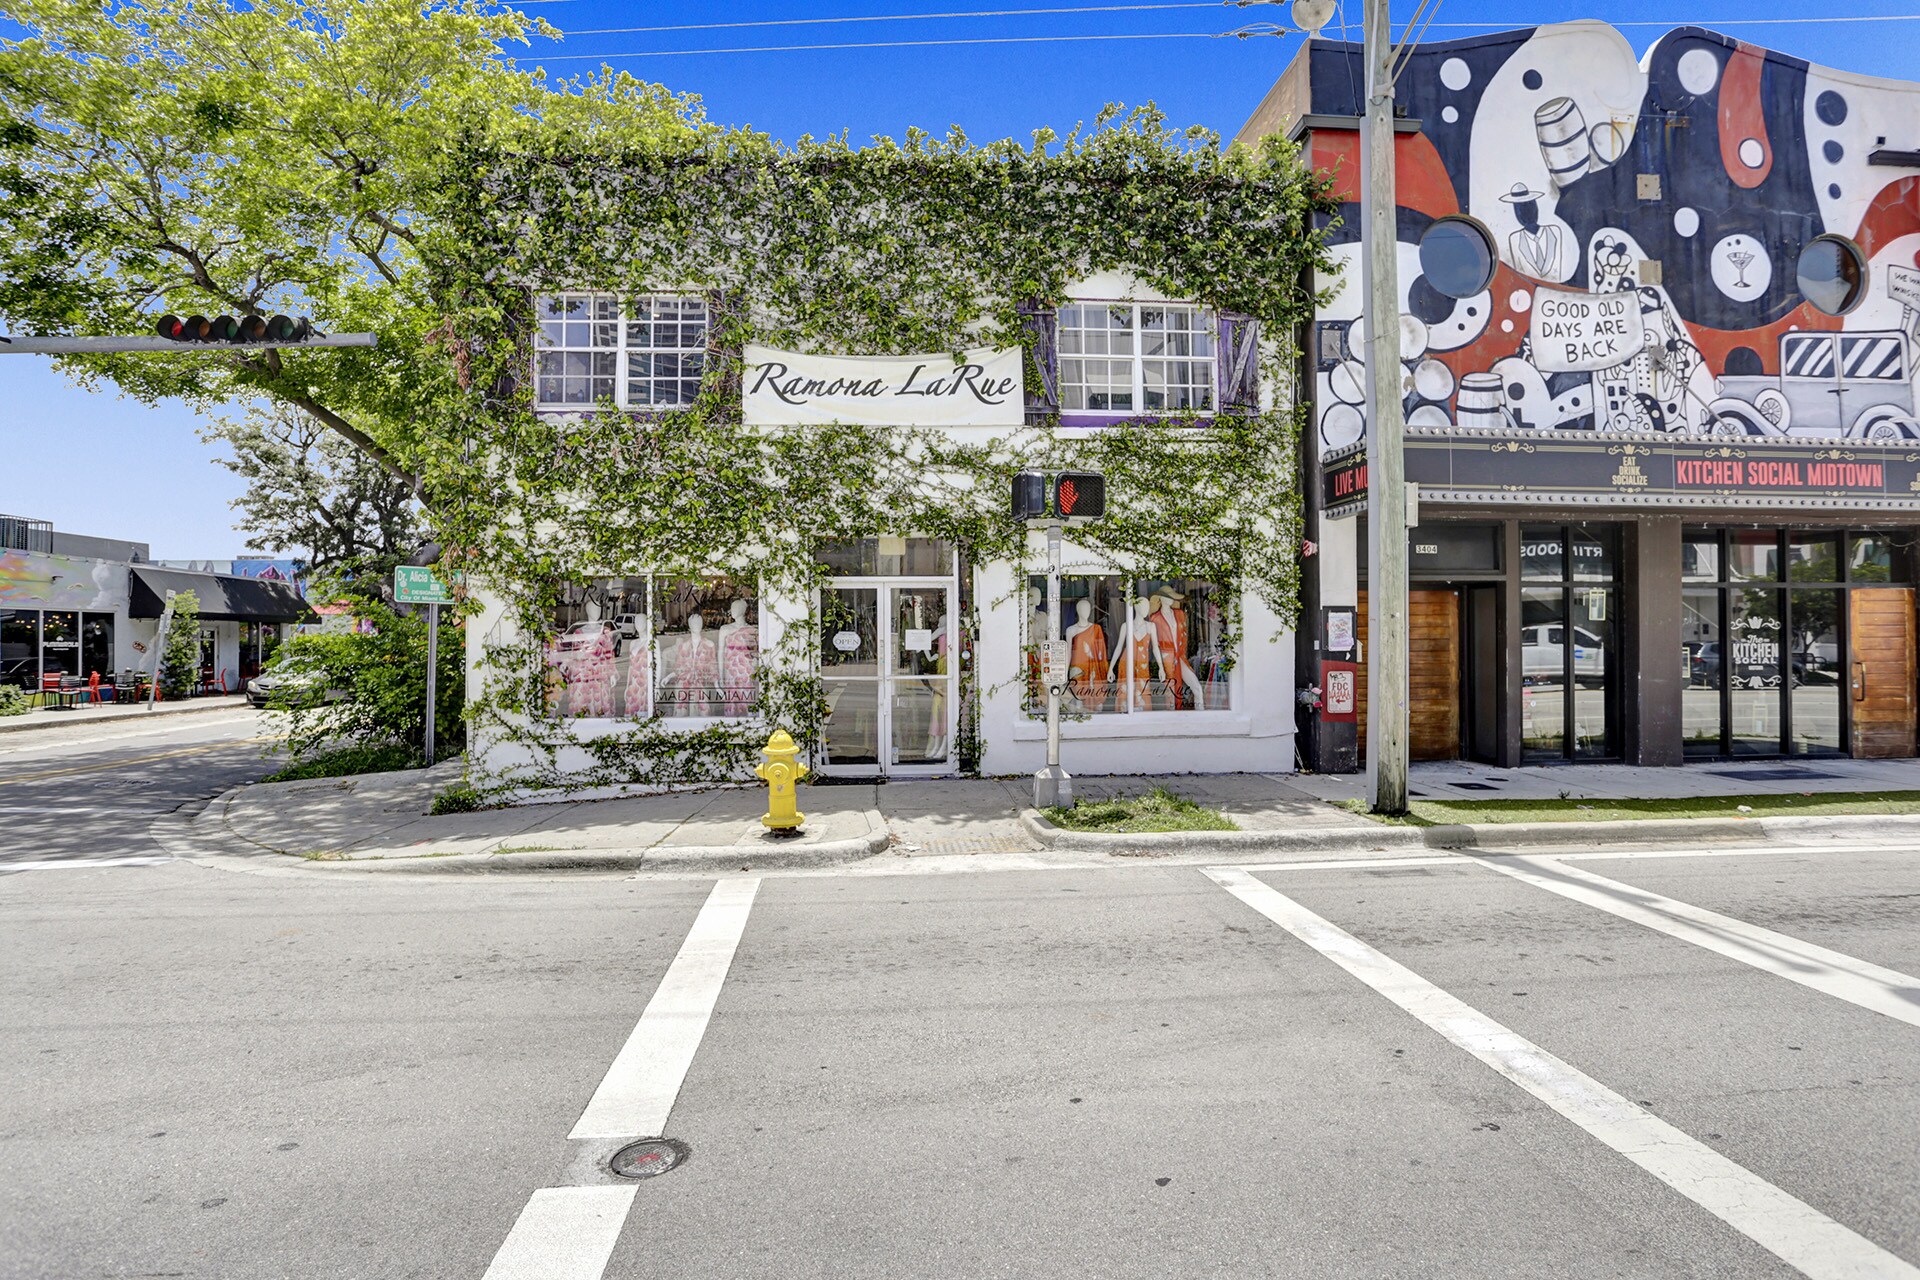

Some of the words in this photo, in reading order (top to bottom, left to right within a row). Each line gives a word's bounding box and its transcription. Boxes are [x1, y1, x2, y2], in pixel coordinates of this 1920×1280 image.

[1541, 299, 1591, 319] GOOD
[1597, 298, 1625, 317] OLD
[1542, 319, 1582, 339] DAYS
[1592, 317, 1628, 336] ARE
[1565, 339, 1618, 363] BACK
[750, 362, 888, 405] Ramona
[894, 363, 1017, 405] LaRue
[1622, 456, 1637, 466] EAT
[1619, 465, 1641, 476] DRINK
[1677, 461, 1743, 485] KITCHEN
[1748, 461, 1803, 486] SOCIAL
[1807, 463, 1883, 487] MIDTOWN
[1335, 470, 1353, 497] LIVE
[1355, 465, 1369, 490] MU
[1612, 475, 1648, 486] SOCIALIZE
[1416, 545, 1437, 553] 3404
[397, 570, 408, 582] Dr.
[410, 571, 428, 582] Alicia
[1747, 634, 1764, 643] The
[1733, 643, 1779, 658] KITCHEN
[1061, 678, 1121, 700] Ramona
[1332, 682, 1349, 691] FDC
[655, 690, 695, 701] MADE
[699, 690, 711, 701] IN
[716, 690, 756, 701] MIAMI
